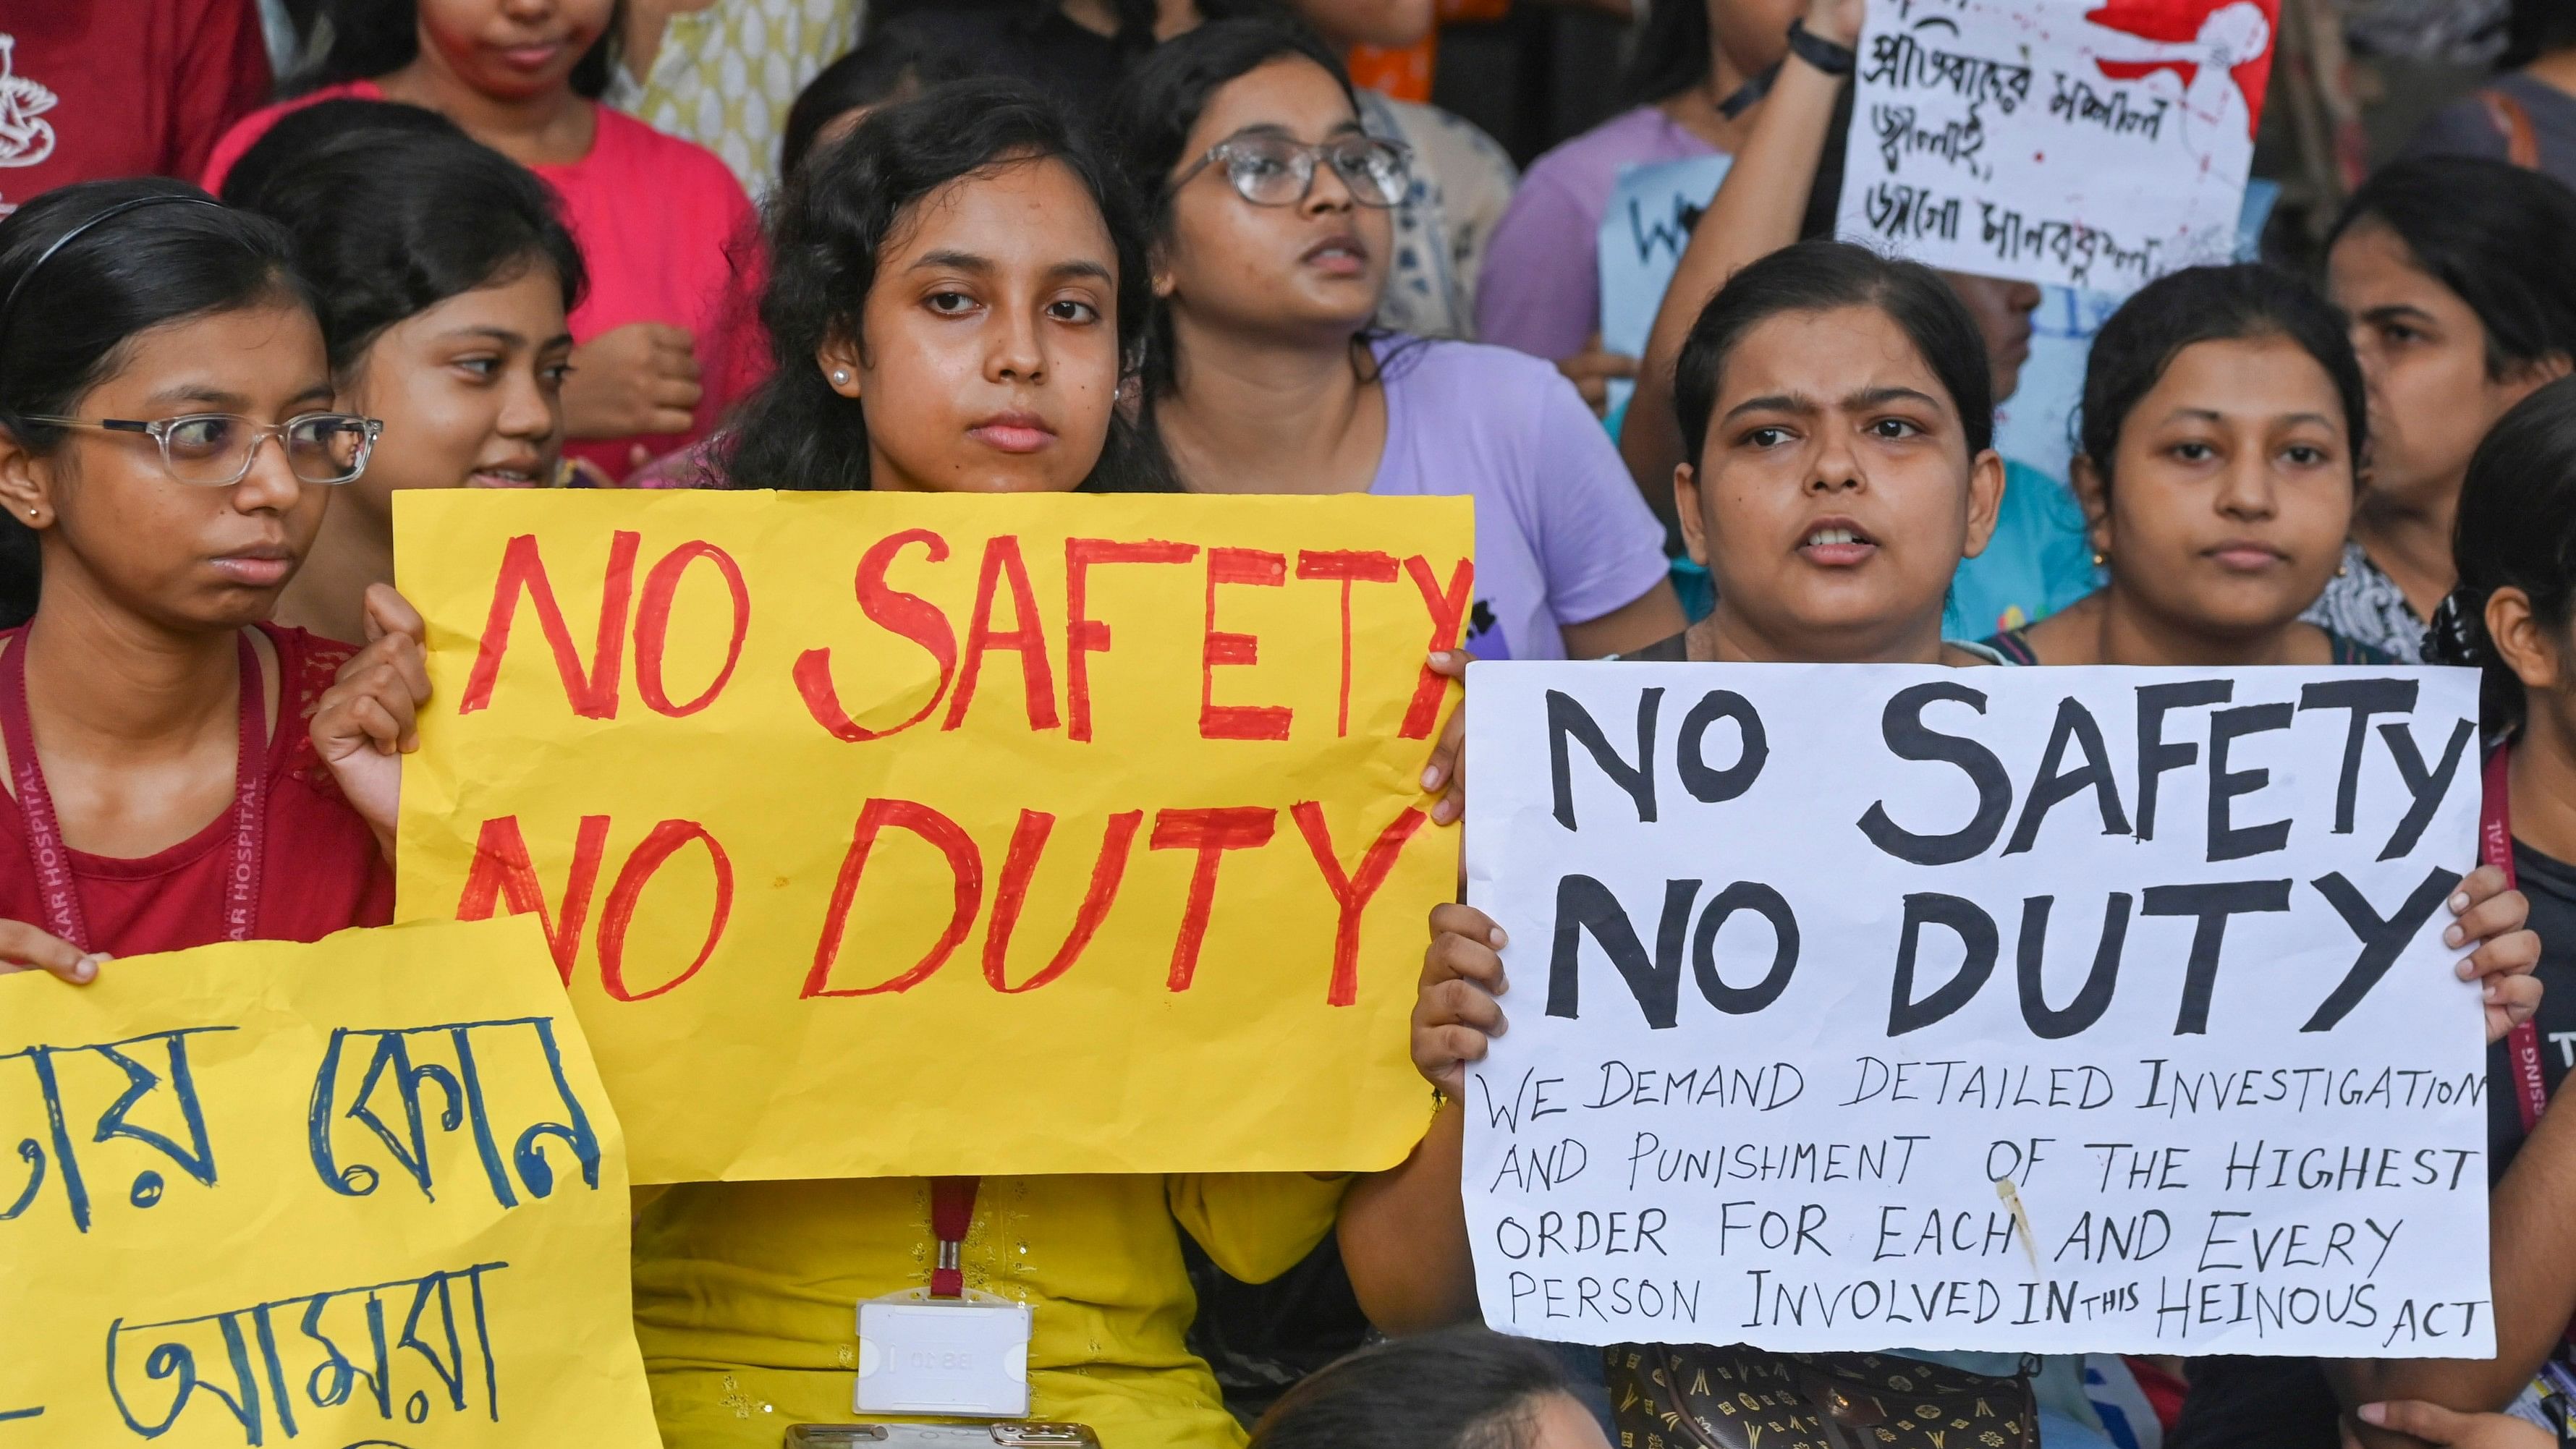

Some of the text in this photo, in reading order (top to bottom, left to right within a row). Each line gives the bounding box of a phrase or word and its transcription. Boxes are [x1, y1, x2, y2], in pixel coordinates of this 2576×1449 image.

[460, 529, 1474, 744] NO SAFETY
[20, 762, 63, 887] HOSPITAL
[1546, 678, 2477, 866] NO SAFETY
[229, 777, 257, 940] AR HOSPITAL
[455, 799, 1428, 1007] NO DUTY
[1545, 866, 2463, 1039] NO DUTY
[309, 1016, 600, 1208] কোন
[1475, 1056, 2487, 1134] WE DEMAND DETAILED INVESTIGATION
[1490, 1131, 2479, 1194] AND PUNISHMENT OF THE HIGHEST
[1496, 1201, 2403, 1279] ORDER FOR EACH AND EVERY
[1509, 1270, 2489, 1348] PERSON INVOLVED IN THIS HEINOUS ACT
[106, 1262, 507, 1445] আমরা
